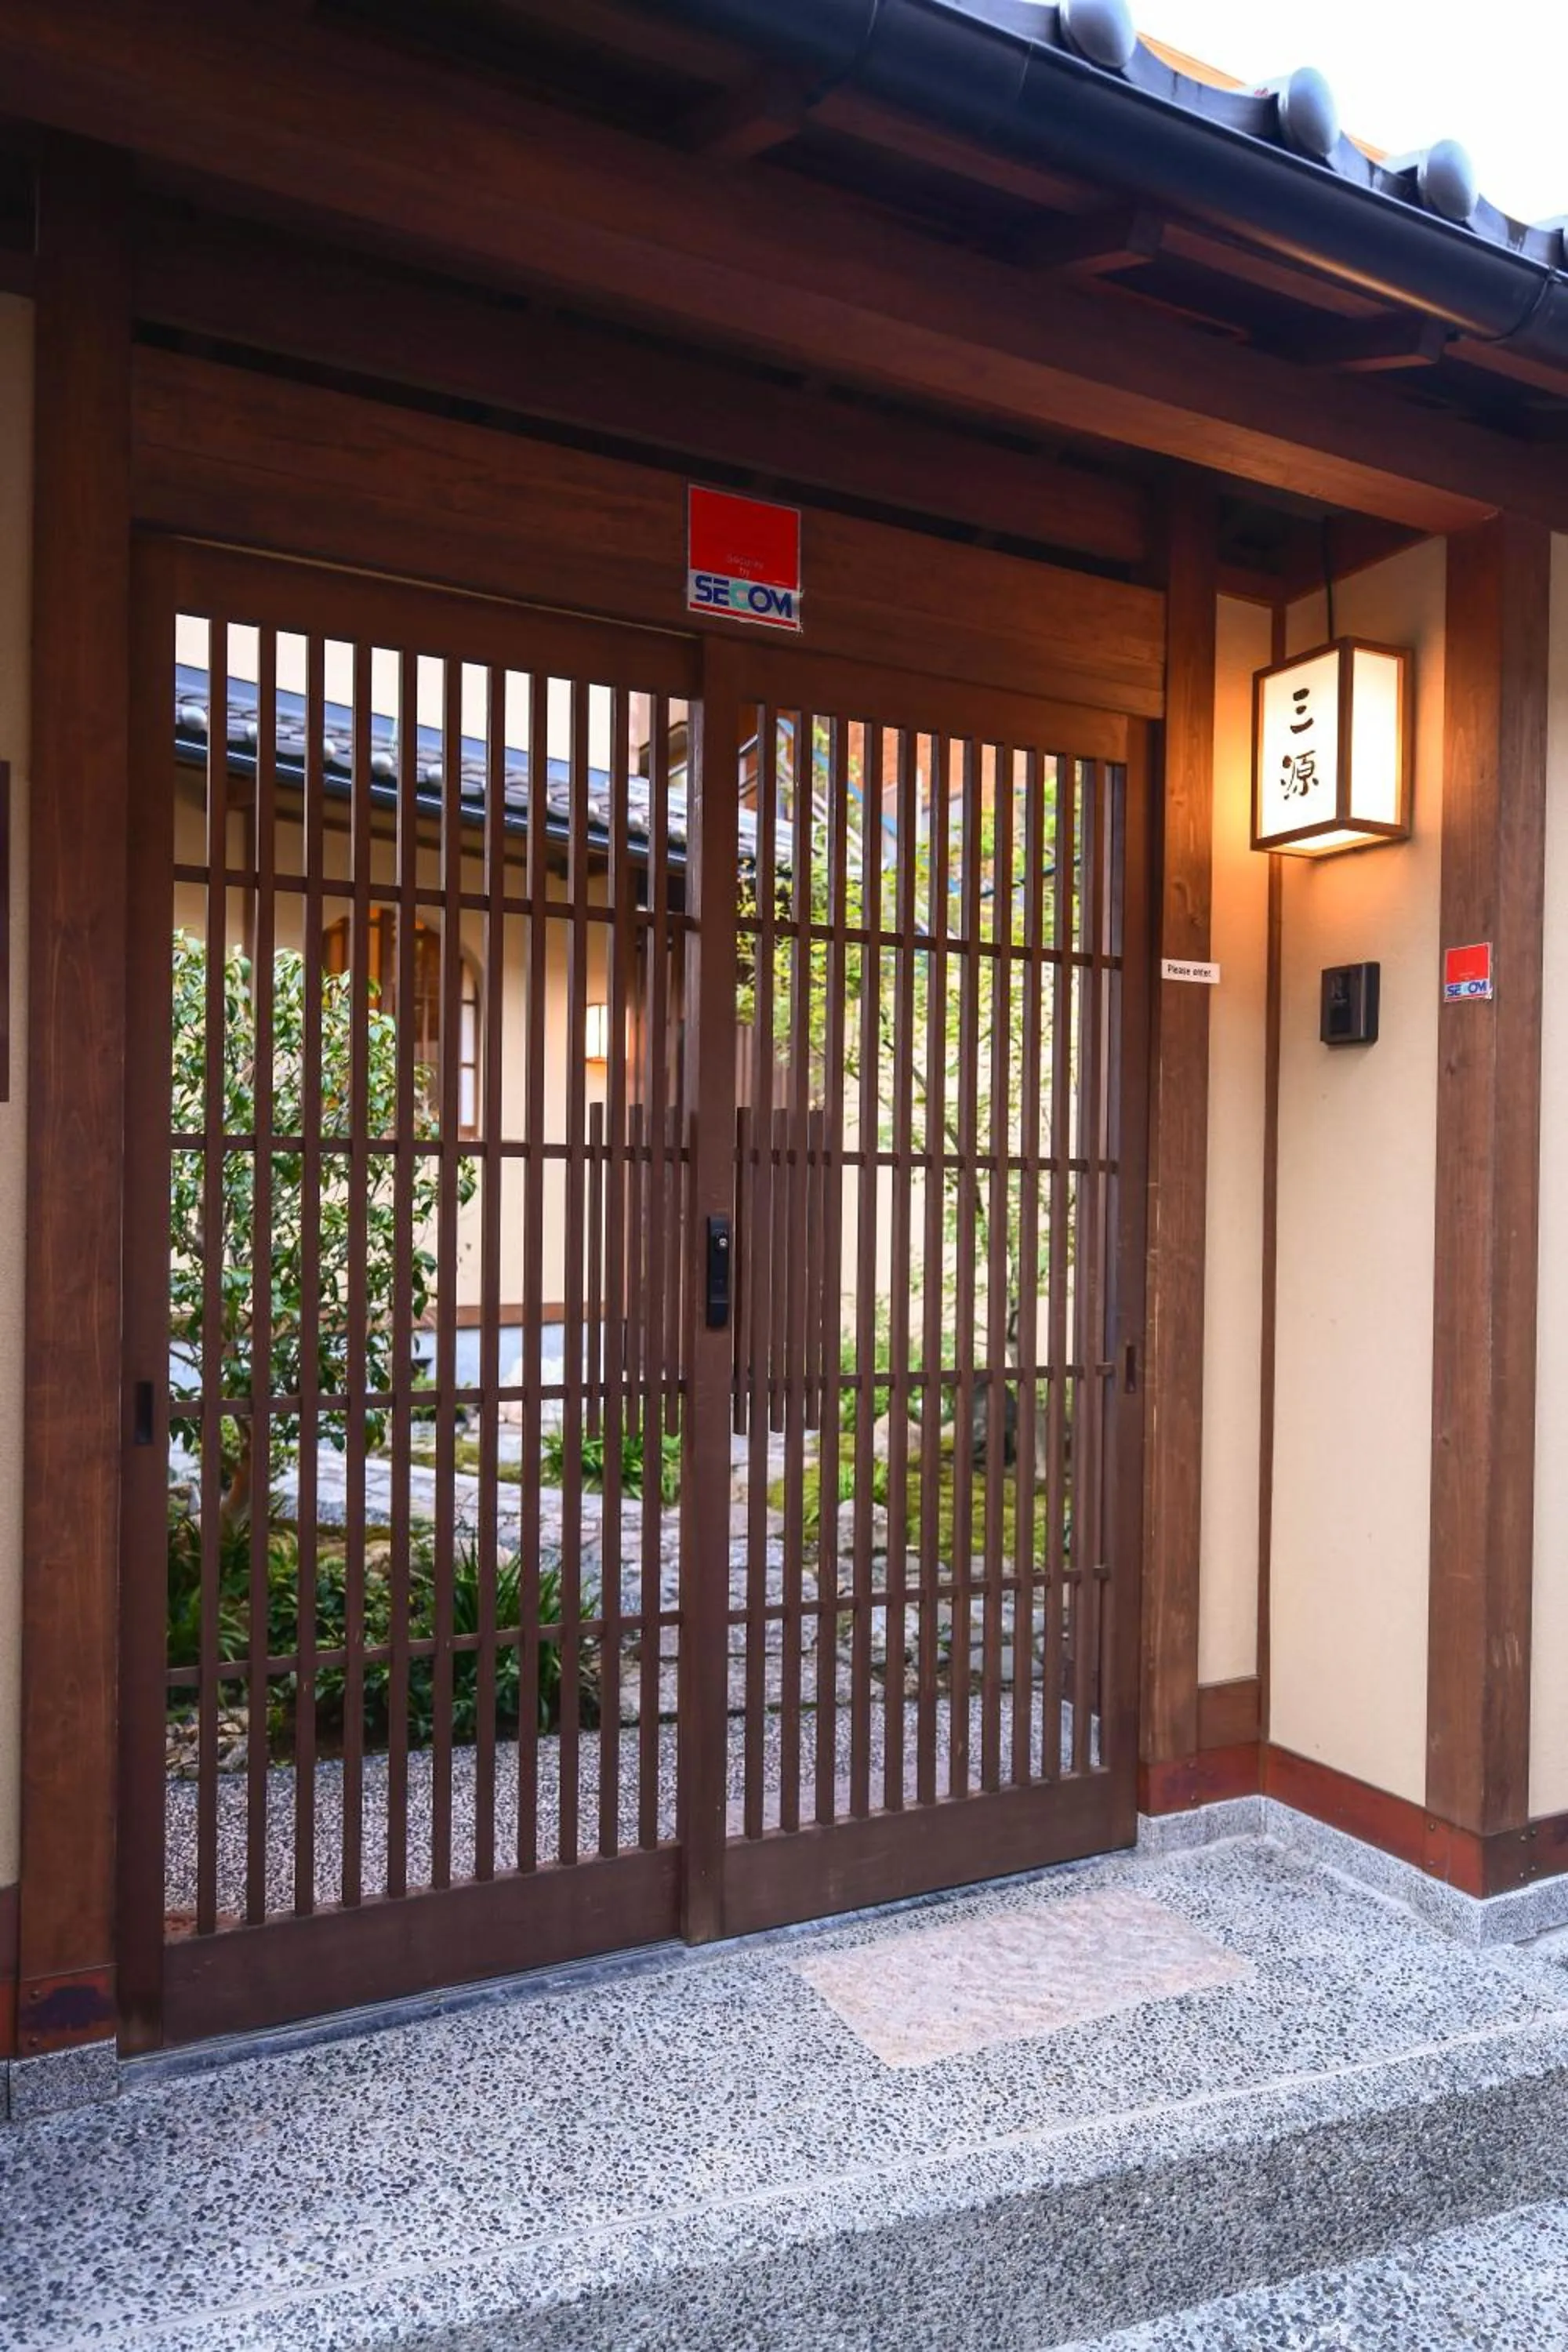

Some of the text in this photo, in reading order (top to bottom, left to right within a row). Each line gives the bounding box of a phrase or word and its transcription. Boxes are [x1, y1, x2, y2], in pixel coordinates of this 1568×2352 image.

[695, 575, 793, 619] SECOM
[1280, 688, 1319, 800] 三源
[1167, 964, 1190, 976] Please
